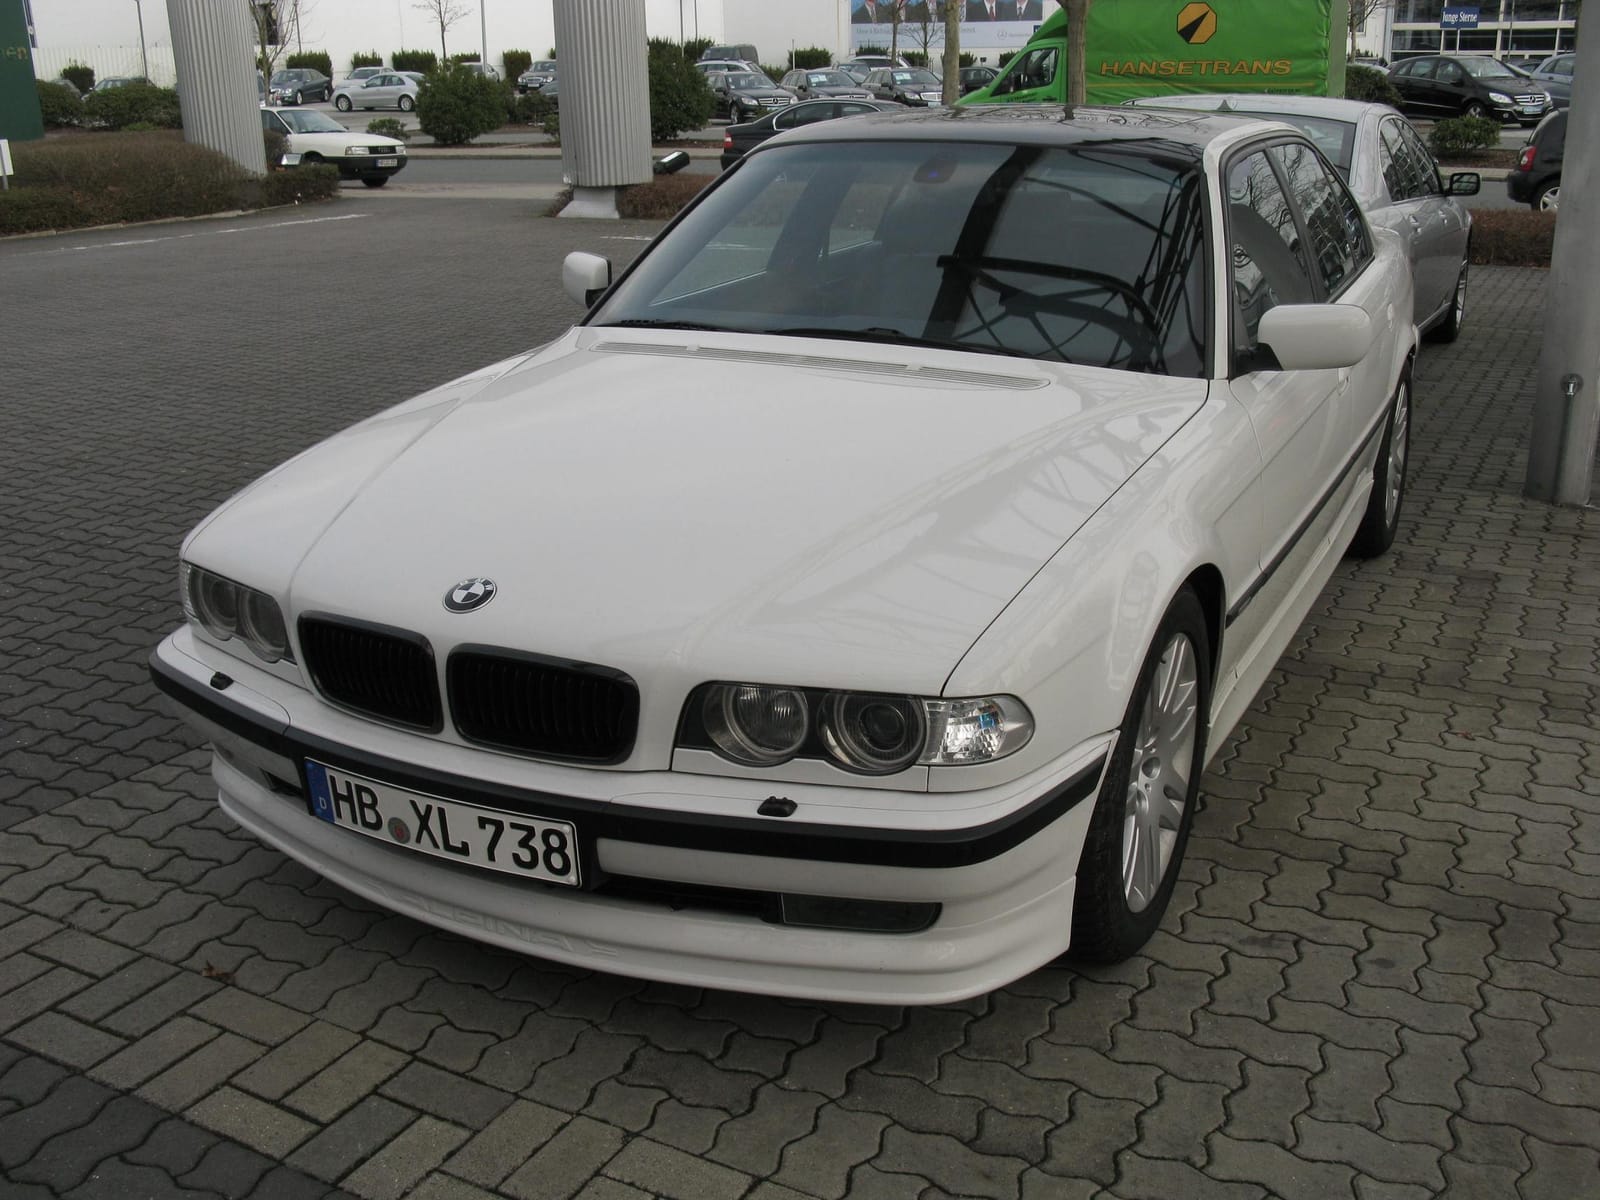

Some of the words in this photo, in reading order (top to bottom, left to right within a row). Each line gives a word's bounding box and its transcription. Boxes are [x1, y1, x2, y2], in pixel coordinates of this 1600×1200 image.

[1442, 11, 1458, 24] Junge
[1459, 11, 1477, 22] Sterne
[1100, 59, 1293, 77] HANSETRANS
[319, 796, 327, 810] D
[329, 775, 383, 831] HB
[409, 799, 470, 857] XL
[477, 816, 572, 877] 738
